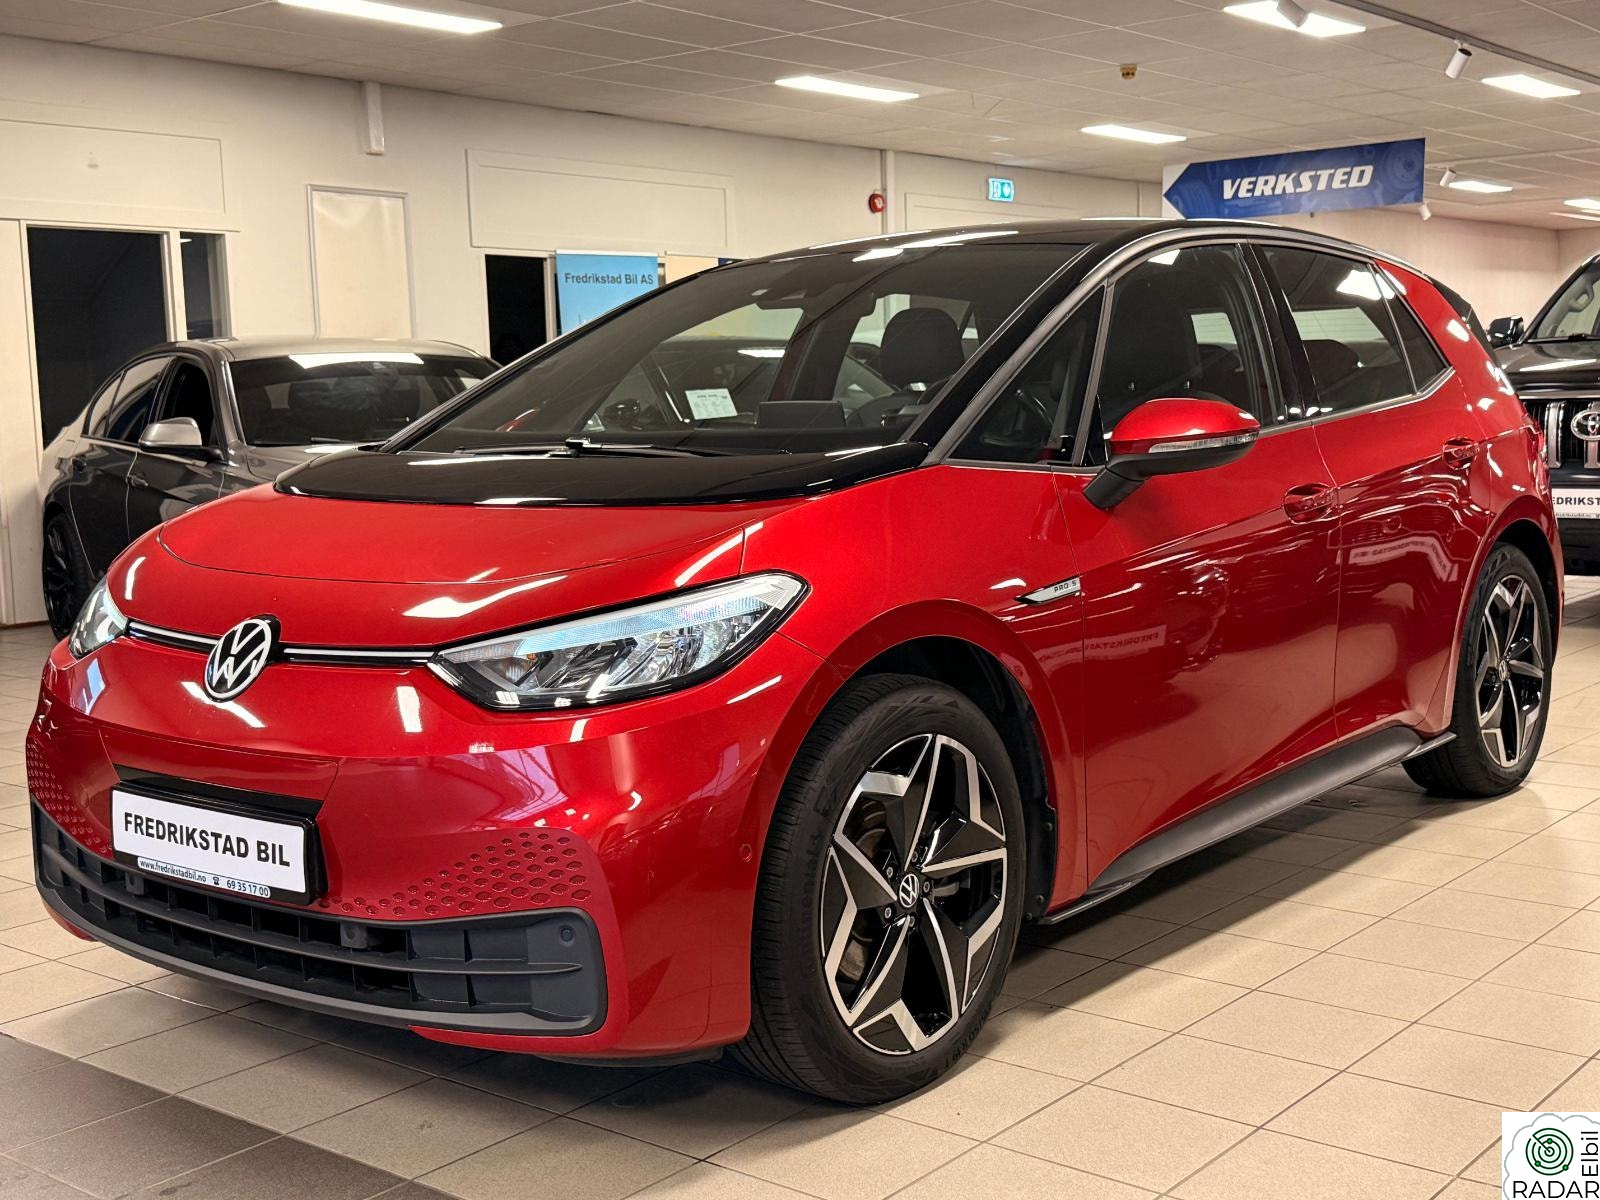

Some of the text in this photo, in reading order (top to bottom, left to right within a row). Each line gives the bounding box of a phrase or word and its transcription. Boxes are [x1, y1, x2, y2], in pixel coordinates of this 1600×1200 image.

[1223, 165, 1374, 200] VERKSTED
[564, 273, 654, 285] Fredrikstad Bil AS
[1054, 583, 1069, 593] PRO
[124, 811, 291, 867] FREDRIKSTAD BIL
[139, 859, 269, 897] www.fredrikstadbil.no 69 35 17 00
